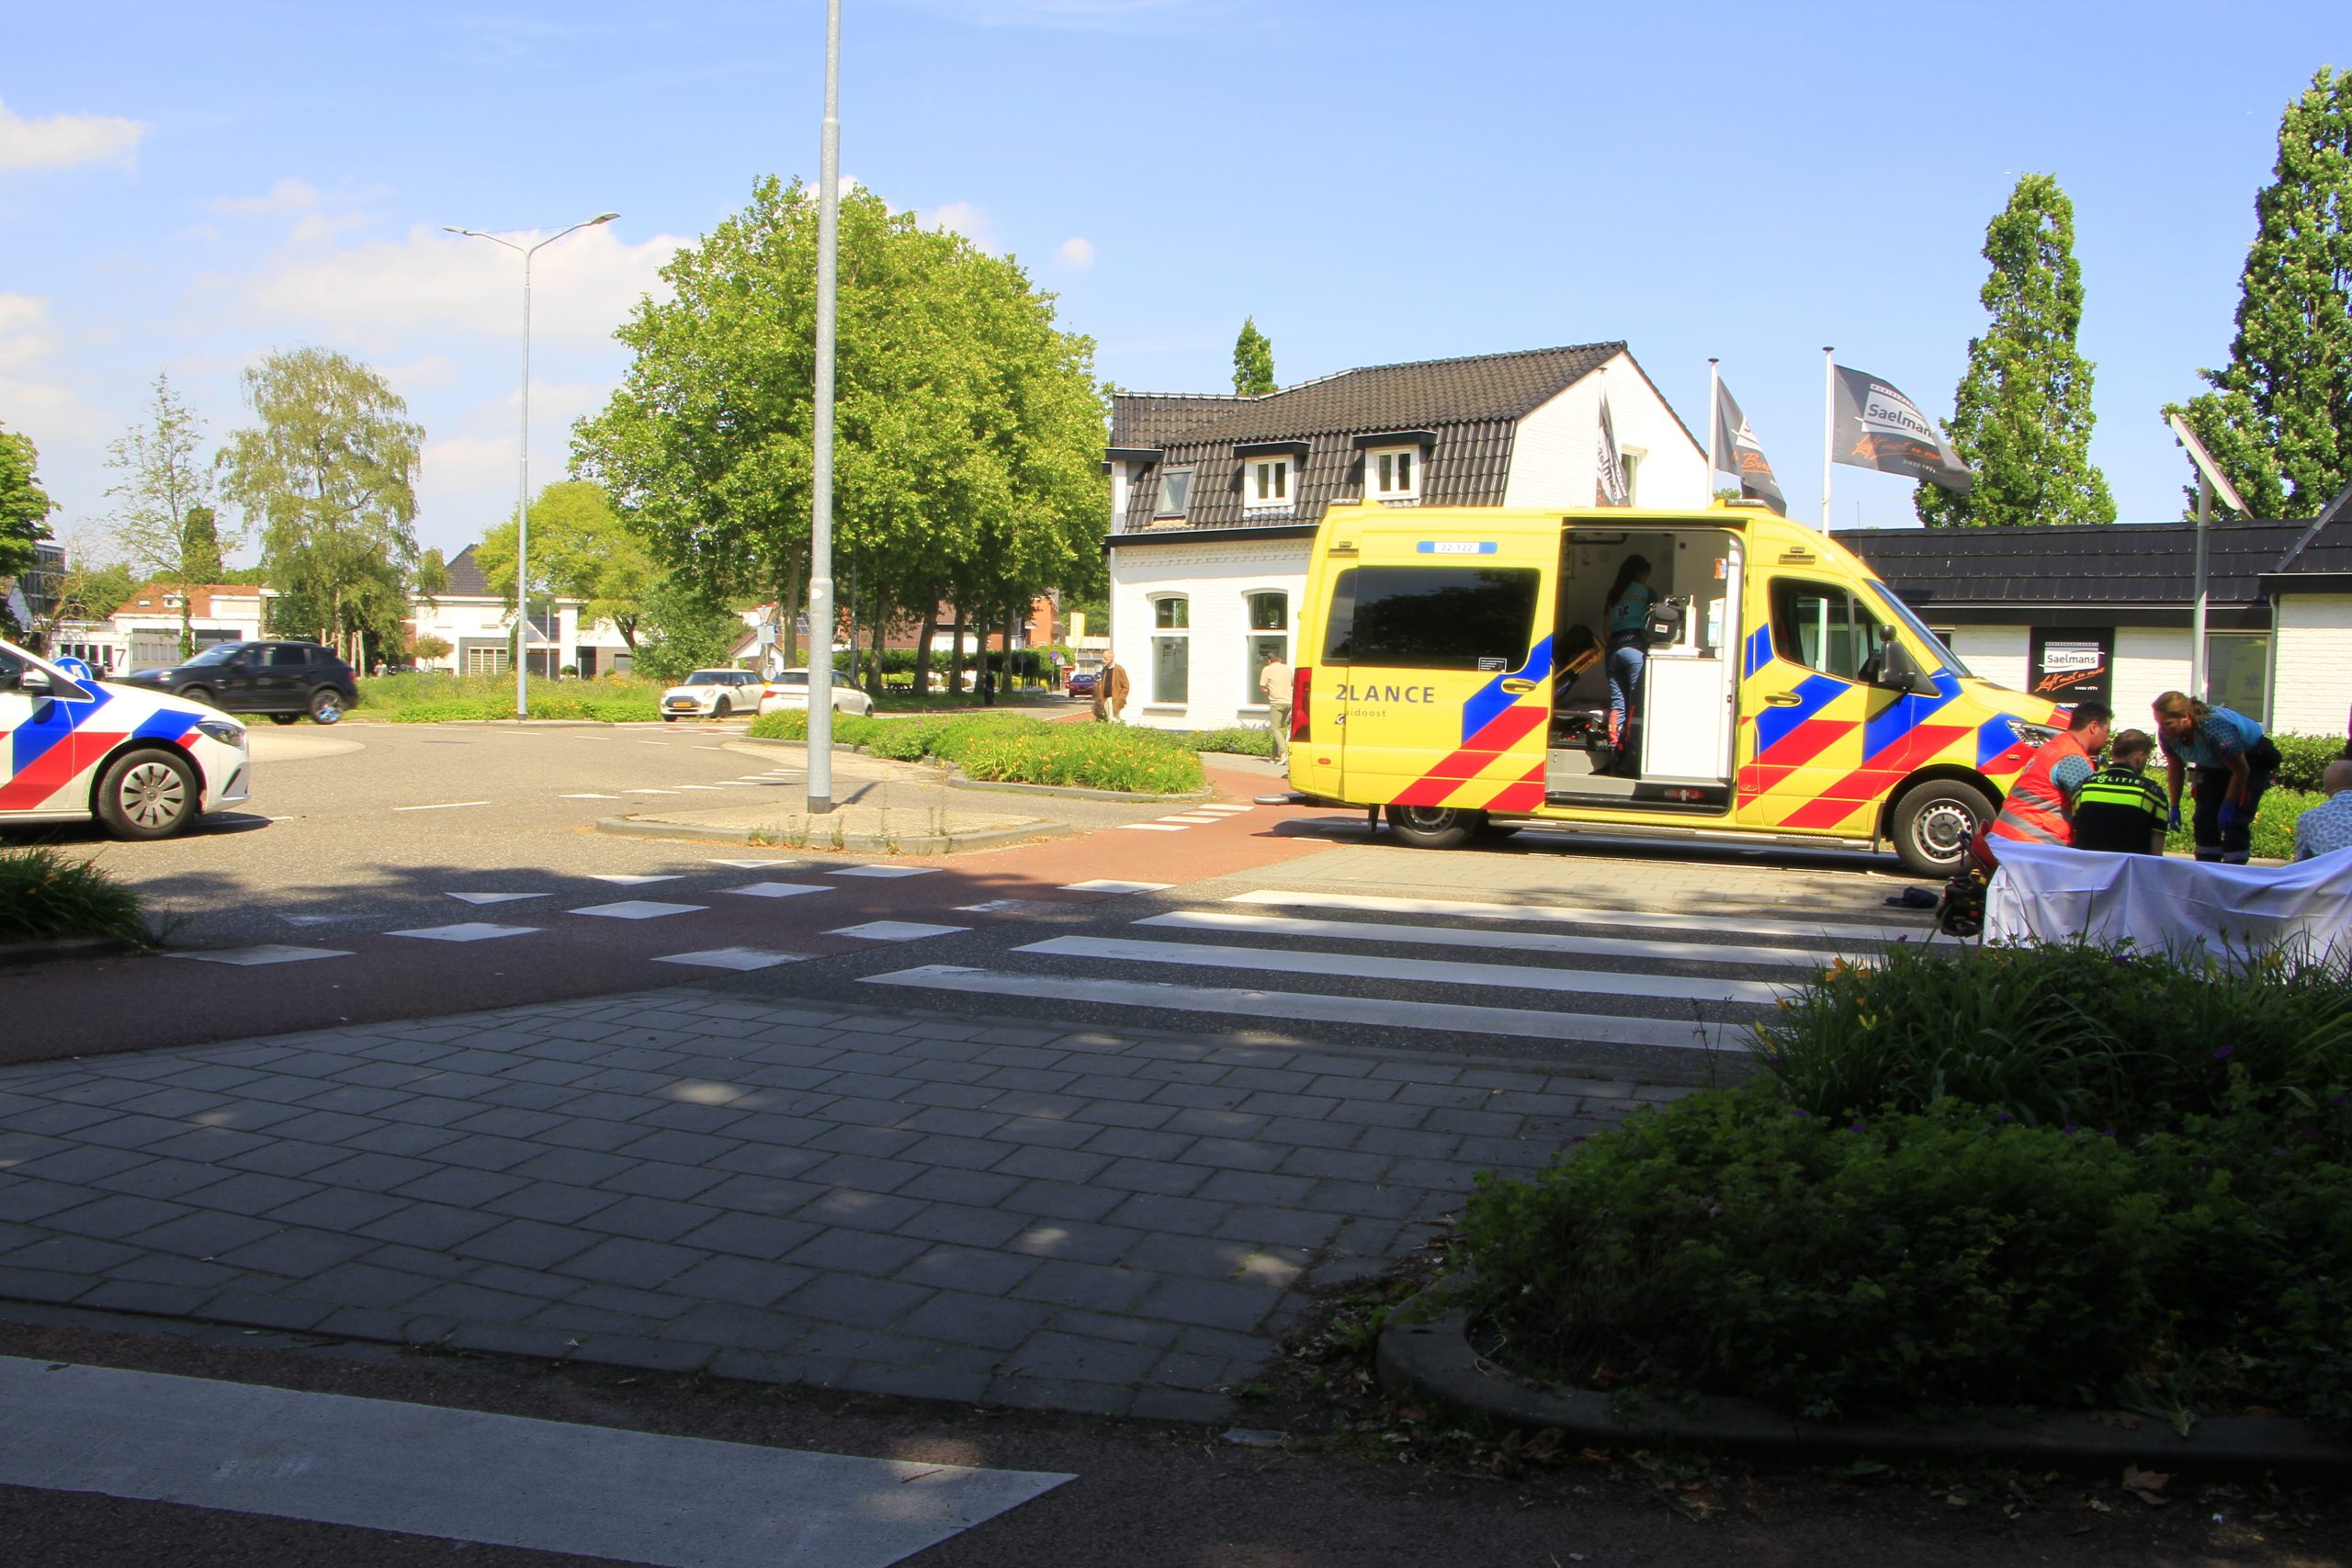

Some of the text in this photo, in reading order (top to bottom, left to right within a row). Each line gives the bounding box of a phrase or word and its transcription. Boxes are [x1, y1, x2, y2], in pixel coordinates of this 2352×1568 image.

[1868, 403, 1933, 438] Saelman
[115, 649, 127, 667] 7
[2047, 654, 2097, 664] Saelmans
